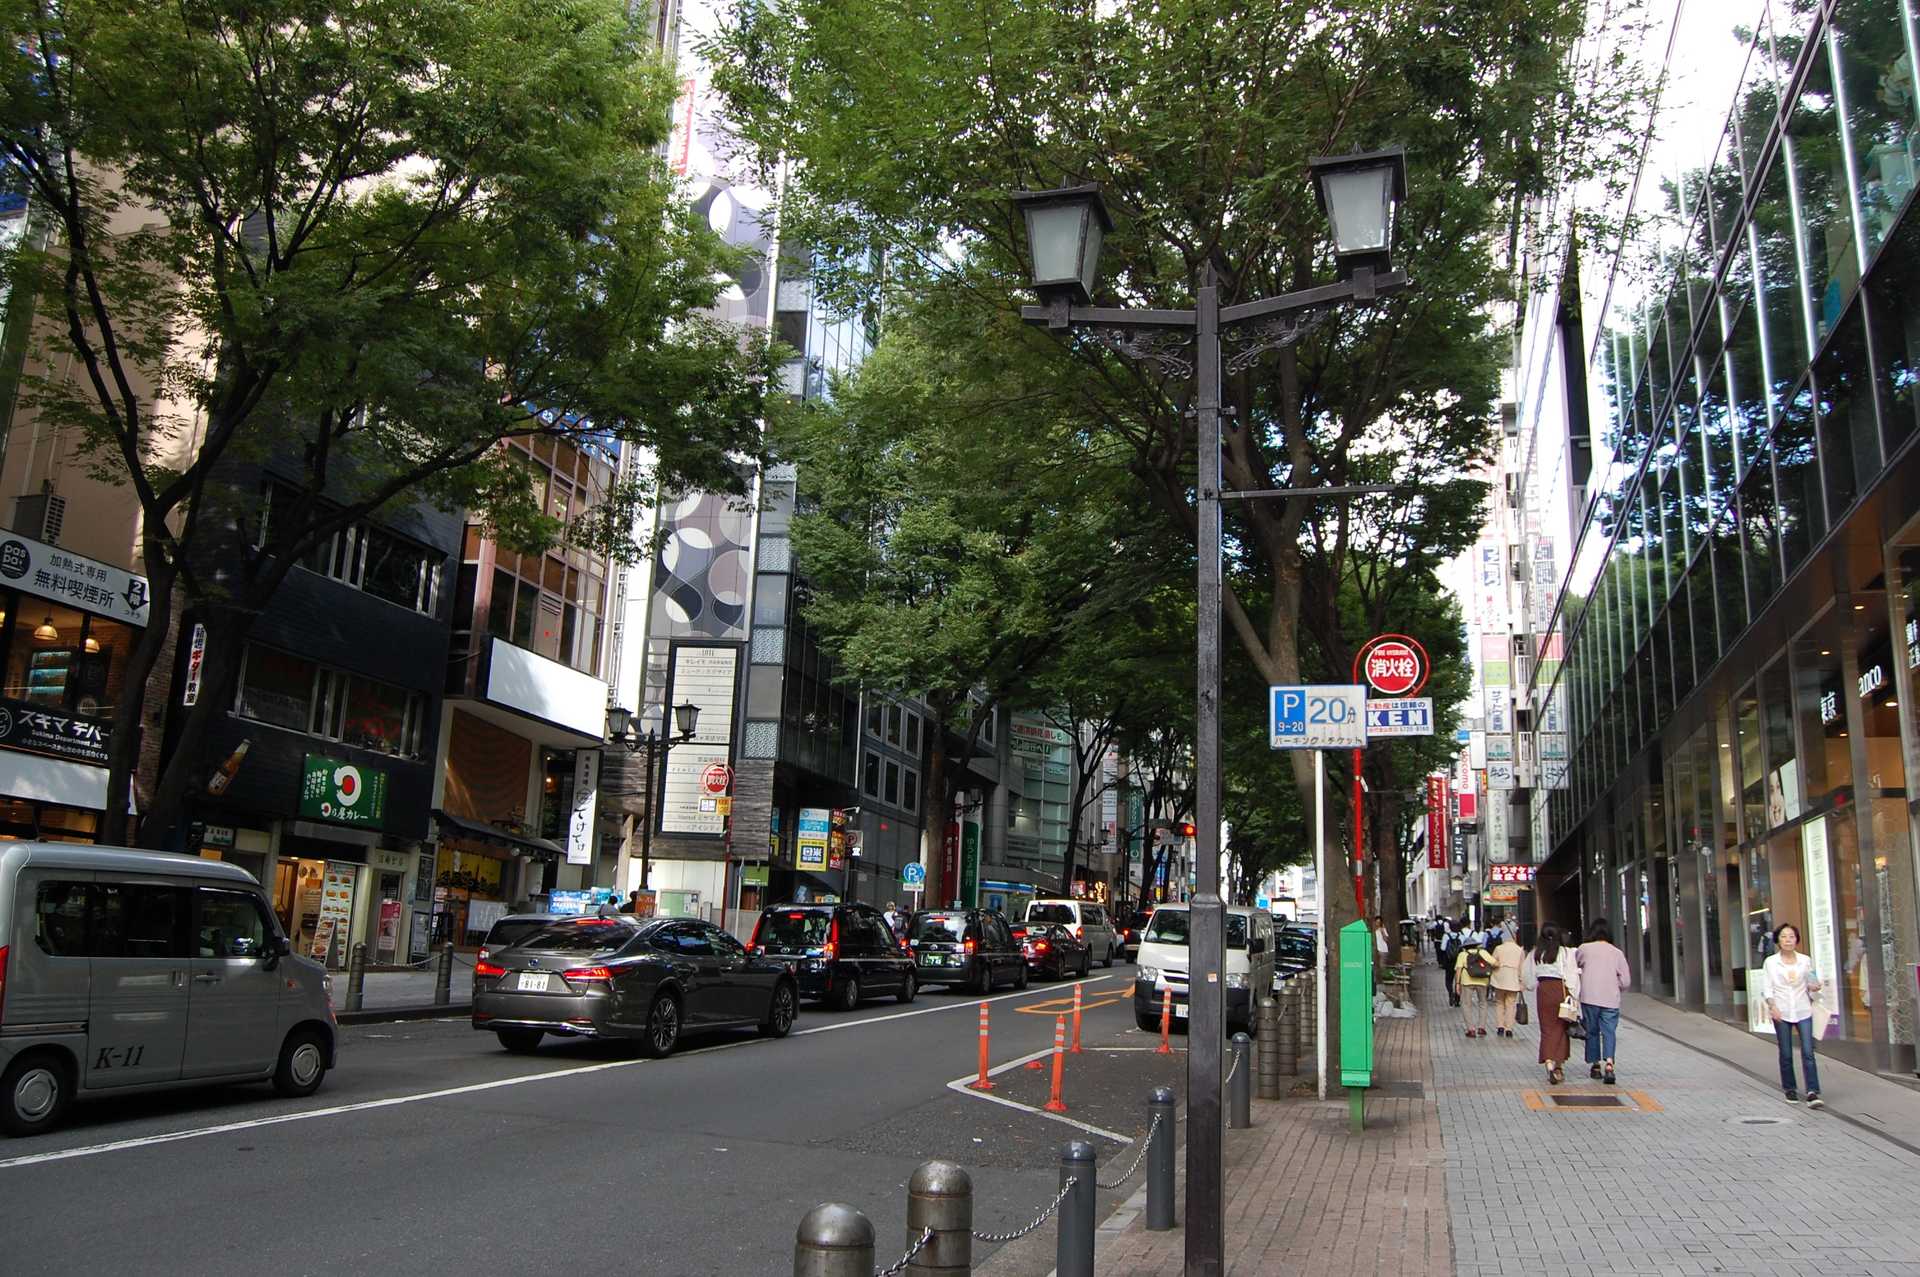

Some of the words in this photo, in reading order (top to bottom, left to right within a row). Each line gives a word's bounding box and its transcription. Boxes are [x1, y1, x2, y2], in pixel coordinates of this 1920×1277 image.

[4, 544, 26, 558] pas
[50, 553, 107, 582] 加熱式専用
[33, 568, 115, 608] 無料喫煙所
[1371, 658, 1414, 677] 消火栓
[1283, 694, 1299, 718] P
[1368, 710, 1424, 726] KEN
[18, 709, 69, 732] スキマ
[72, 721, 113, 741] デパー
[1461, 750, 1469, 790] docomo
